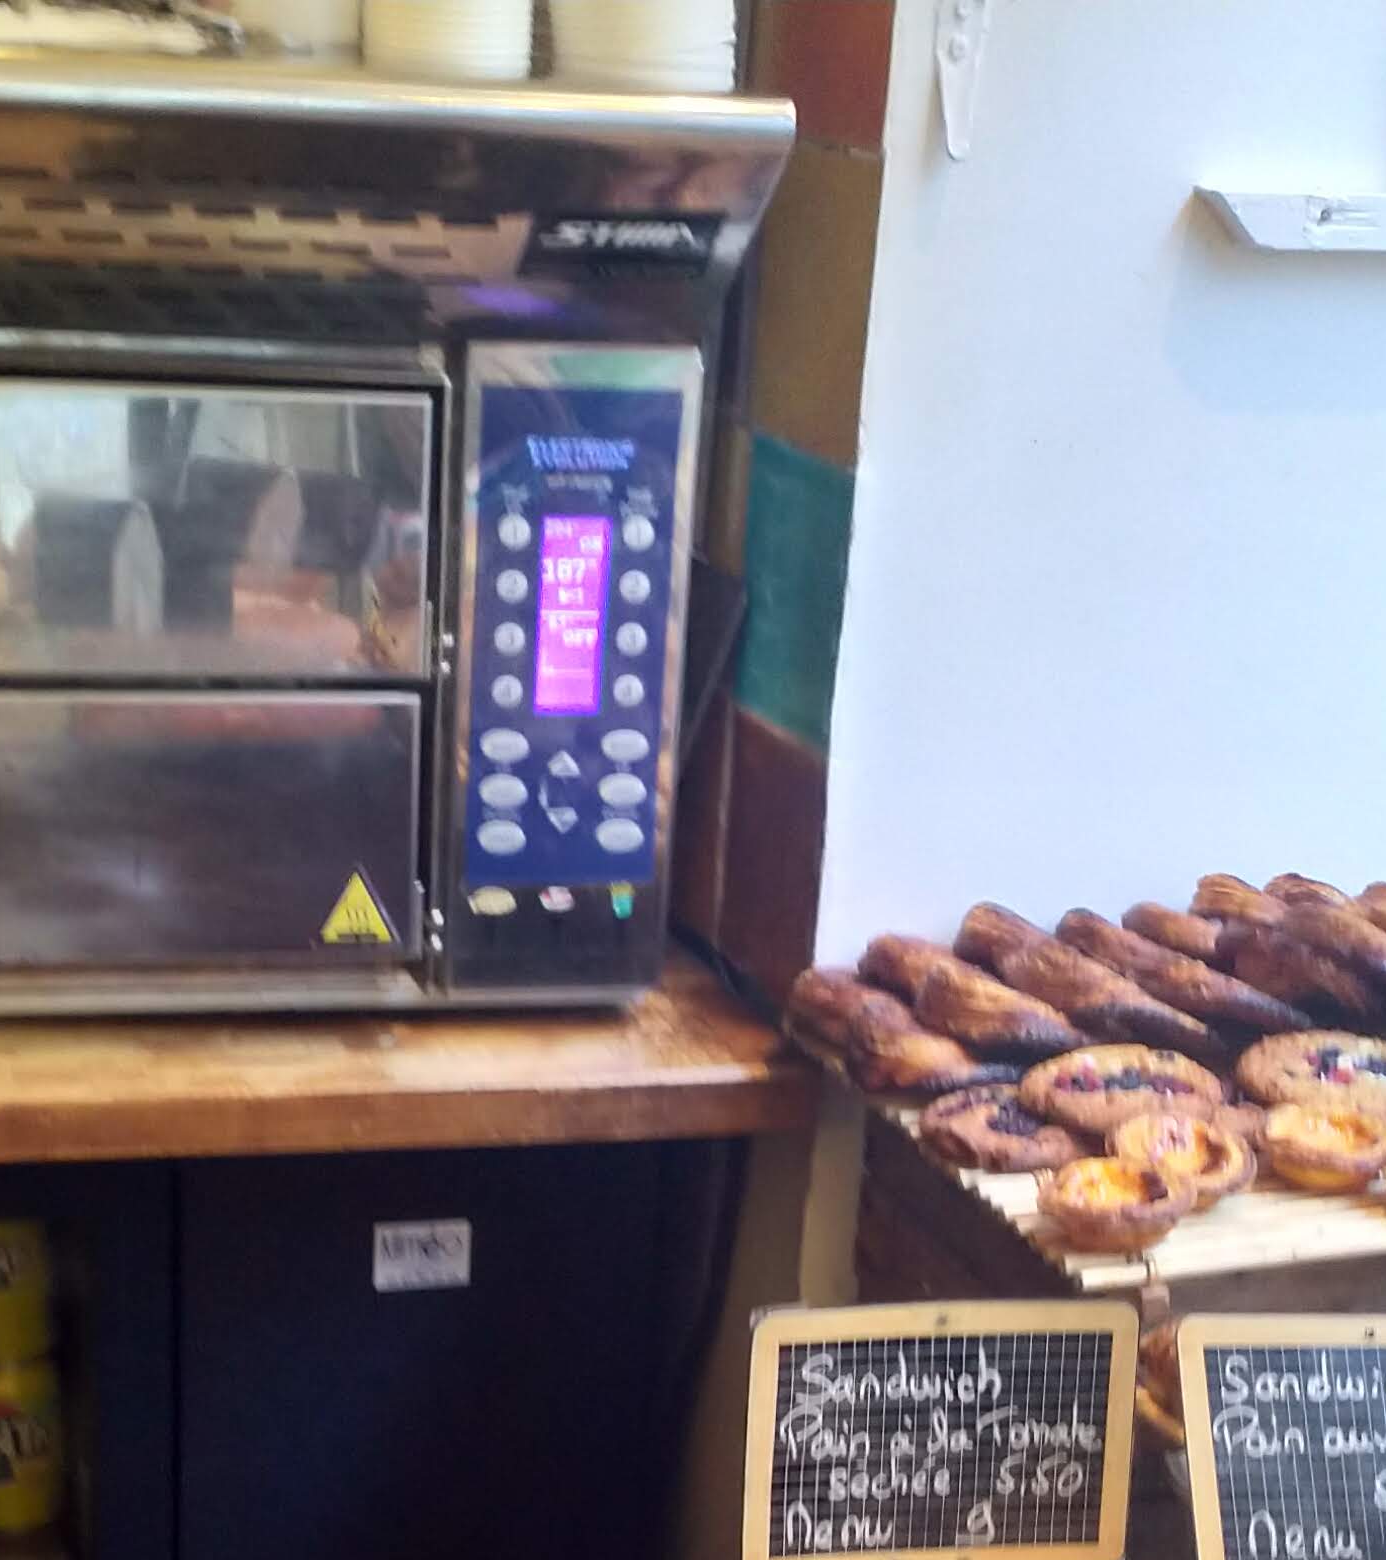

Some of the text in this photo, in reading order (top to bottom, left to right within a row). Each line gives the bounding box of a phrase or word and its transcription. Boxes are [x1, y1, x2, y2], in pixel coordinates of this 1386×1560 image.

[795, 1344, 1002, 1405] Sandwich
[780, 1404, 870, 1461] Pain
[1214, 1405, 1304, 1458] Pain
[787, 1500, 893, 1549] Menu
[1248, 1508, 1363, 1560] Menu
